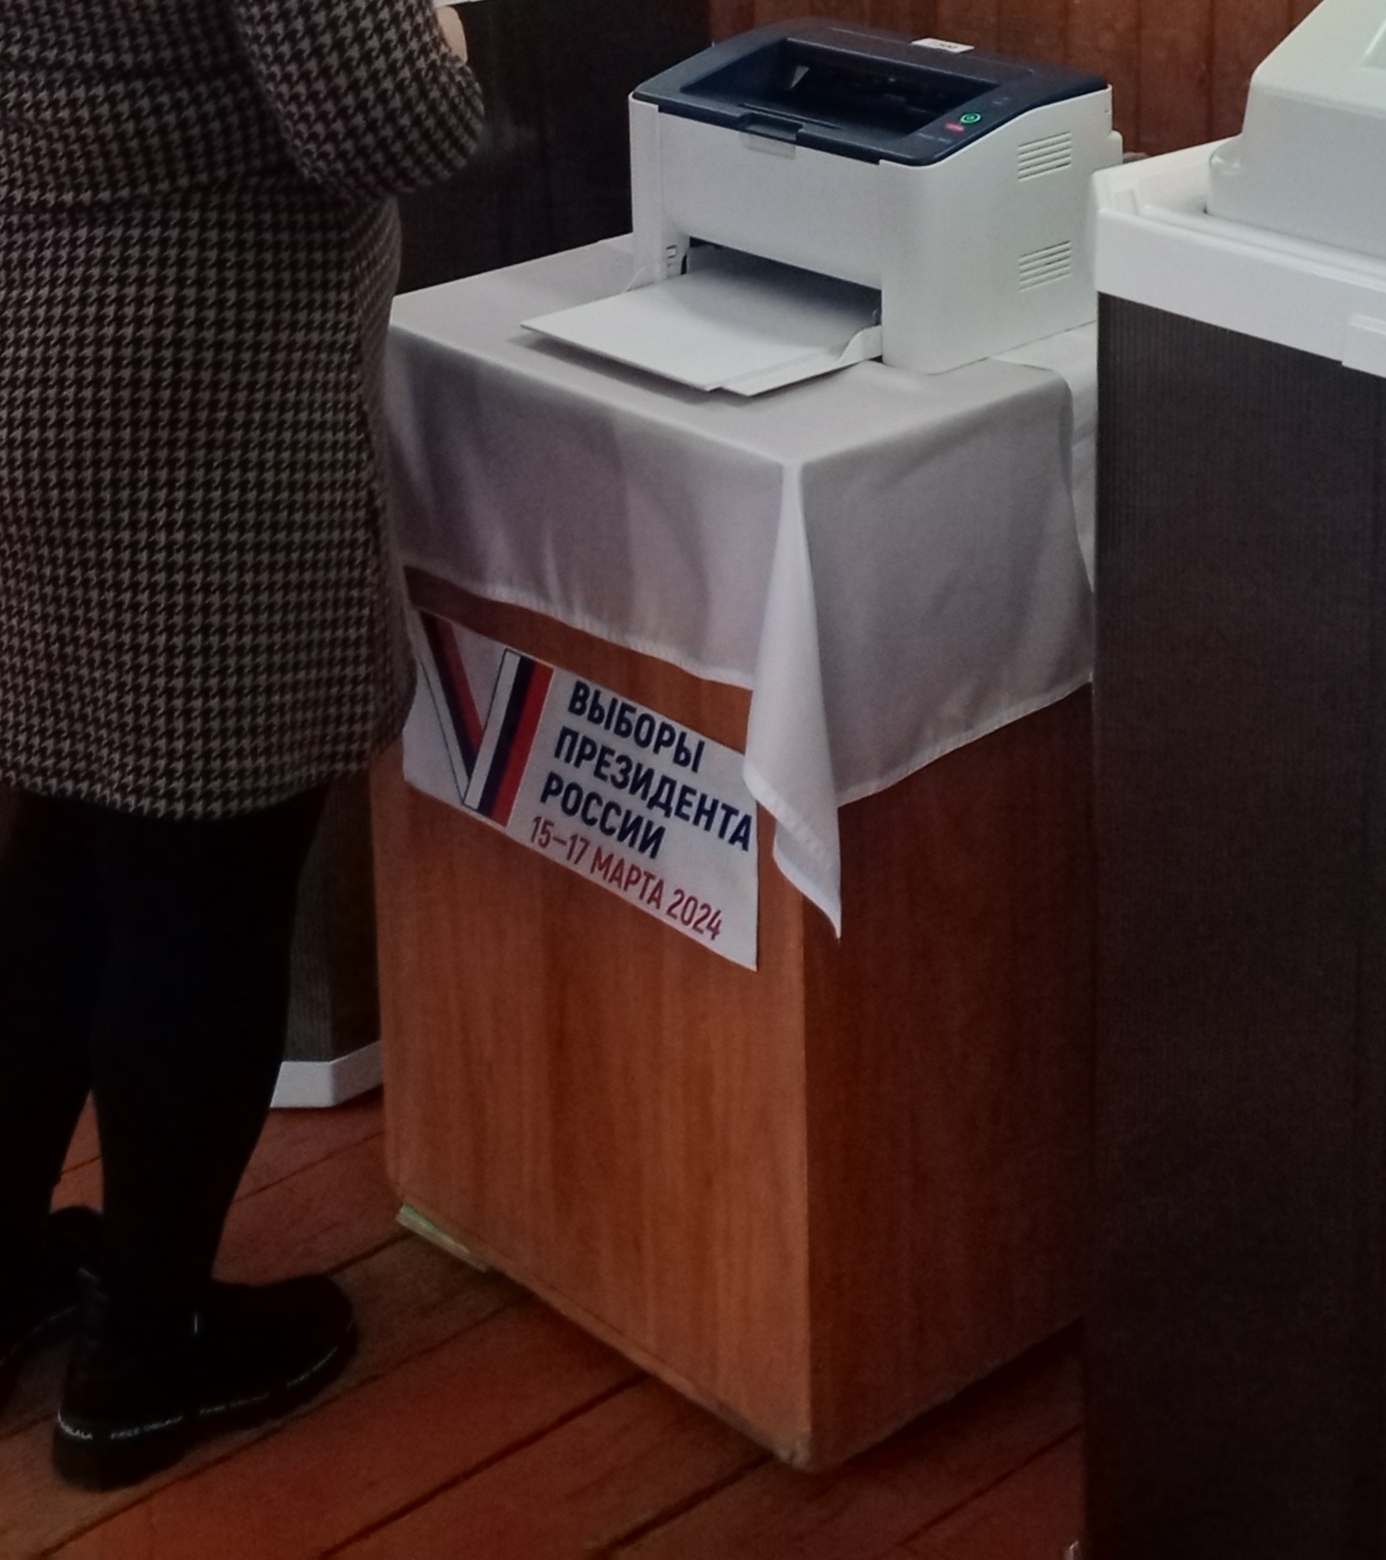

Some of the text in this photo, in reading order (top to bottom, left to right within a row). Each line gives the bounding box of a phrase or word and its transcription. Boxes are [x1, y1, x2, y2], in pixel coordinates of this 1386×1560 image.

[567, 680, 706, 773] ВЫБОРЫ
[540, 771, 667, 859] РОССИИ
[553, 725, 753, 852] ПРЕЗИДЕНТА
[589, 845, 665, 910] МАРТА
[666, 889, 723, 941] 2024
